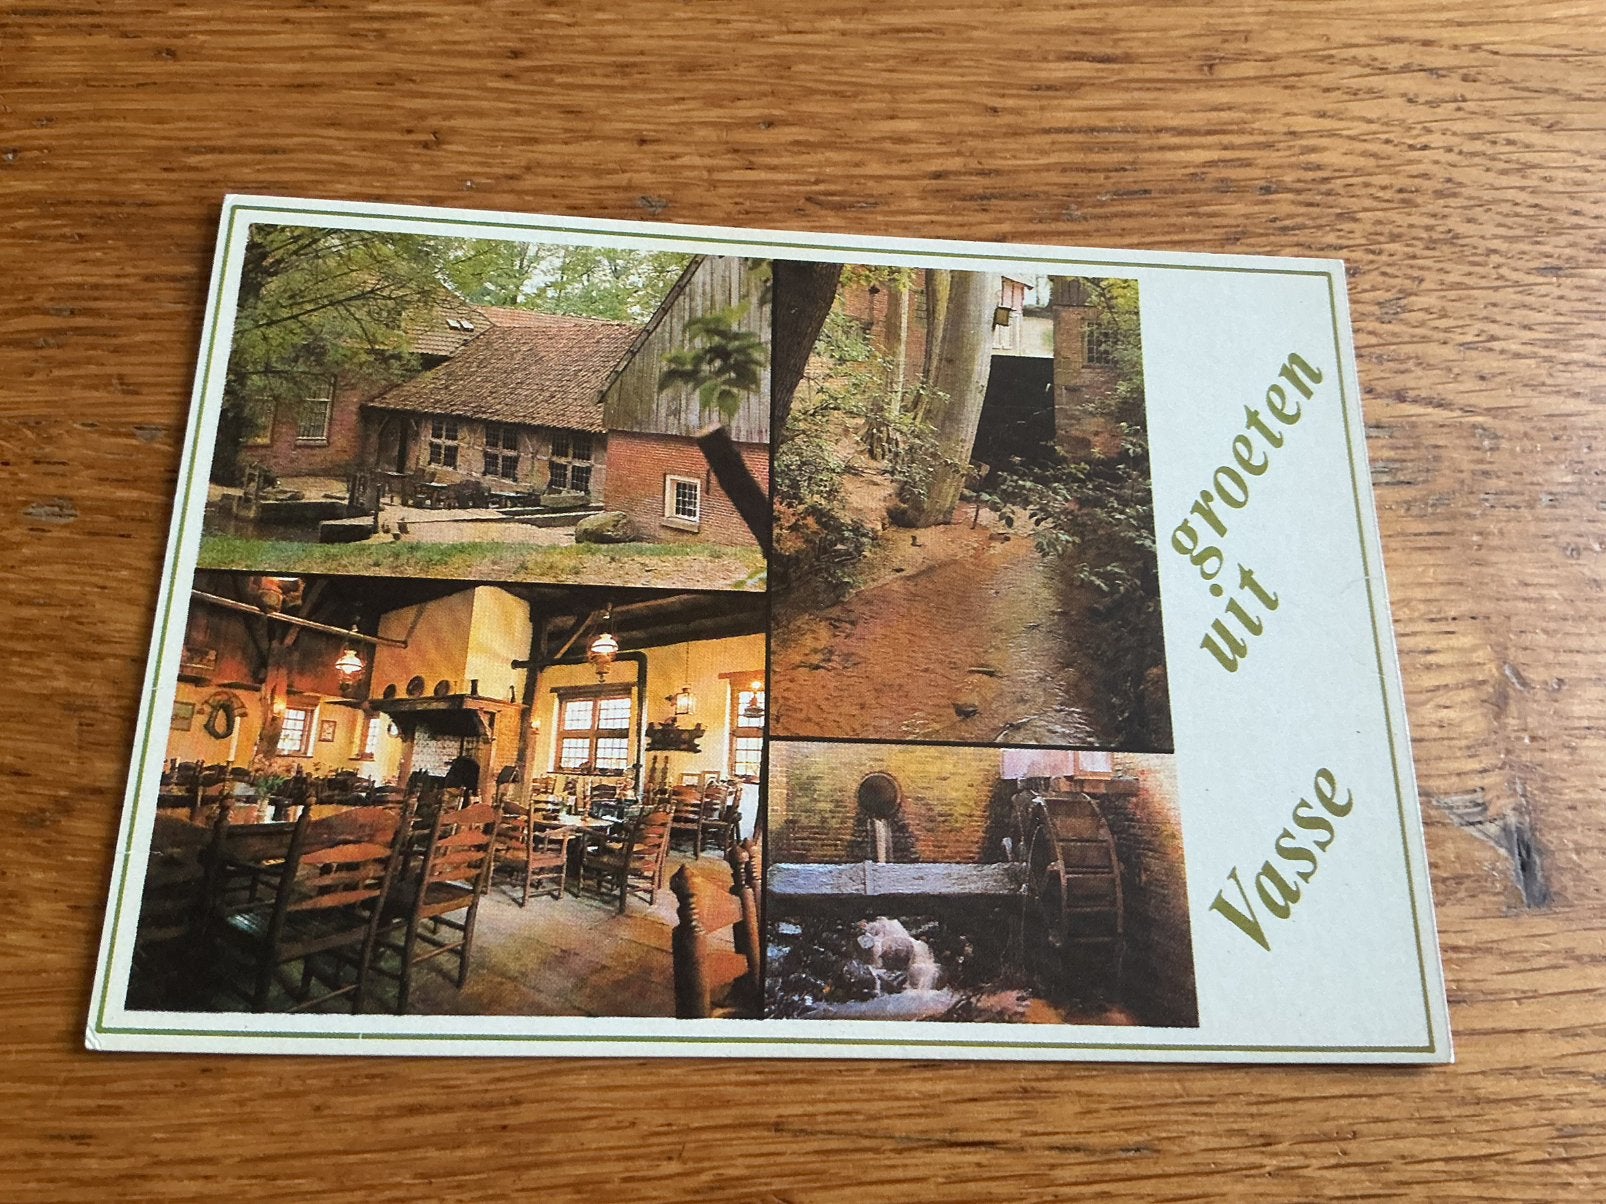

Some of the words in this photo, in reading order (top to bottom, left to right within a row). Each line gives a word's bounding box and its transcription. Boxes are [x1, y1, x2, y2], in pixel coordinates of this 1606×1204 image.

[1171, 349, 1324, 583] groeten
[1198, 562, 1280, 674] uit
[1209, 765, 1355, 953] Vasse
